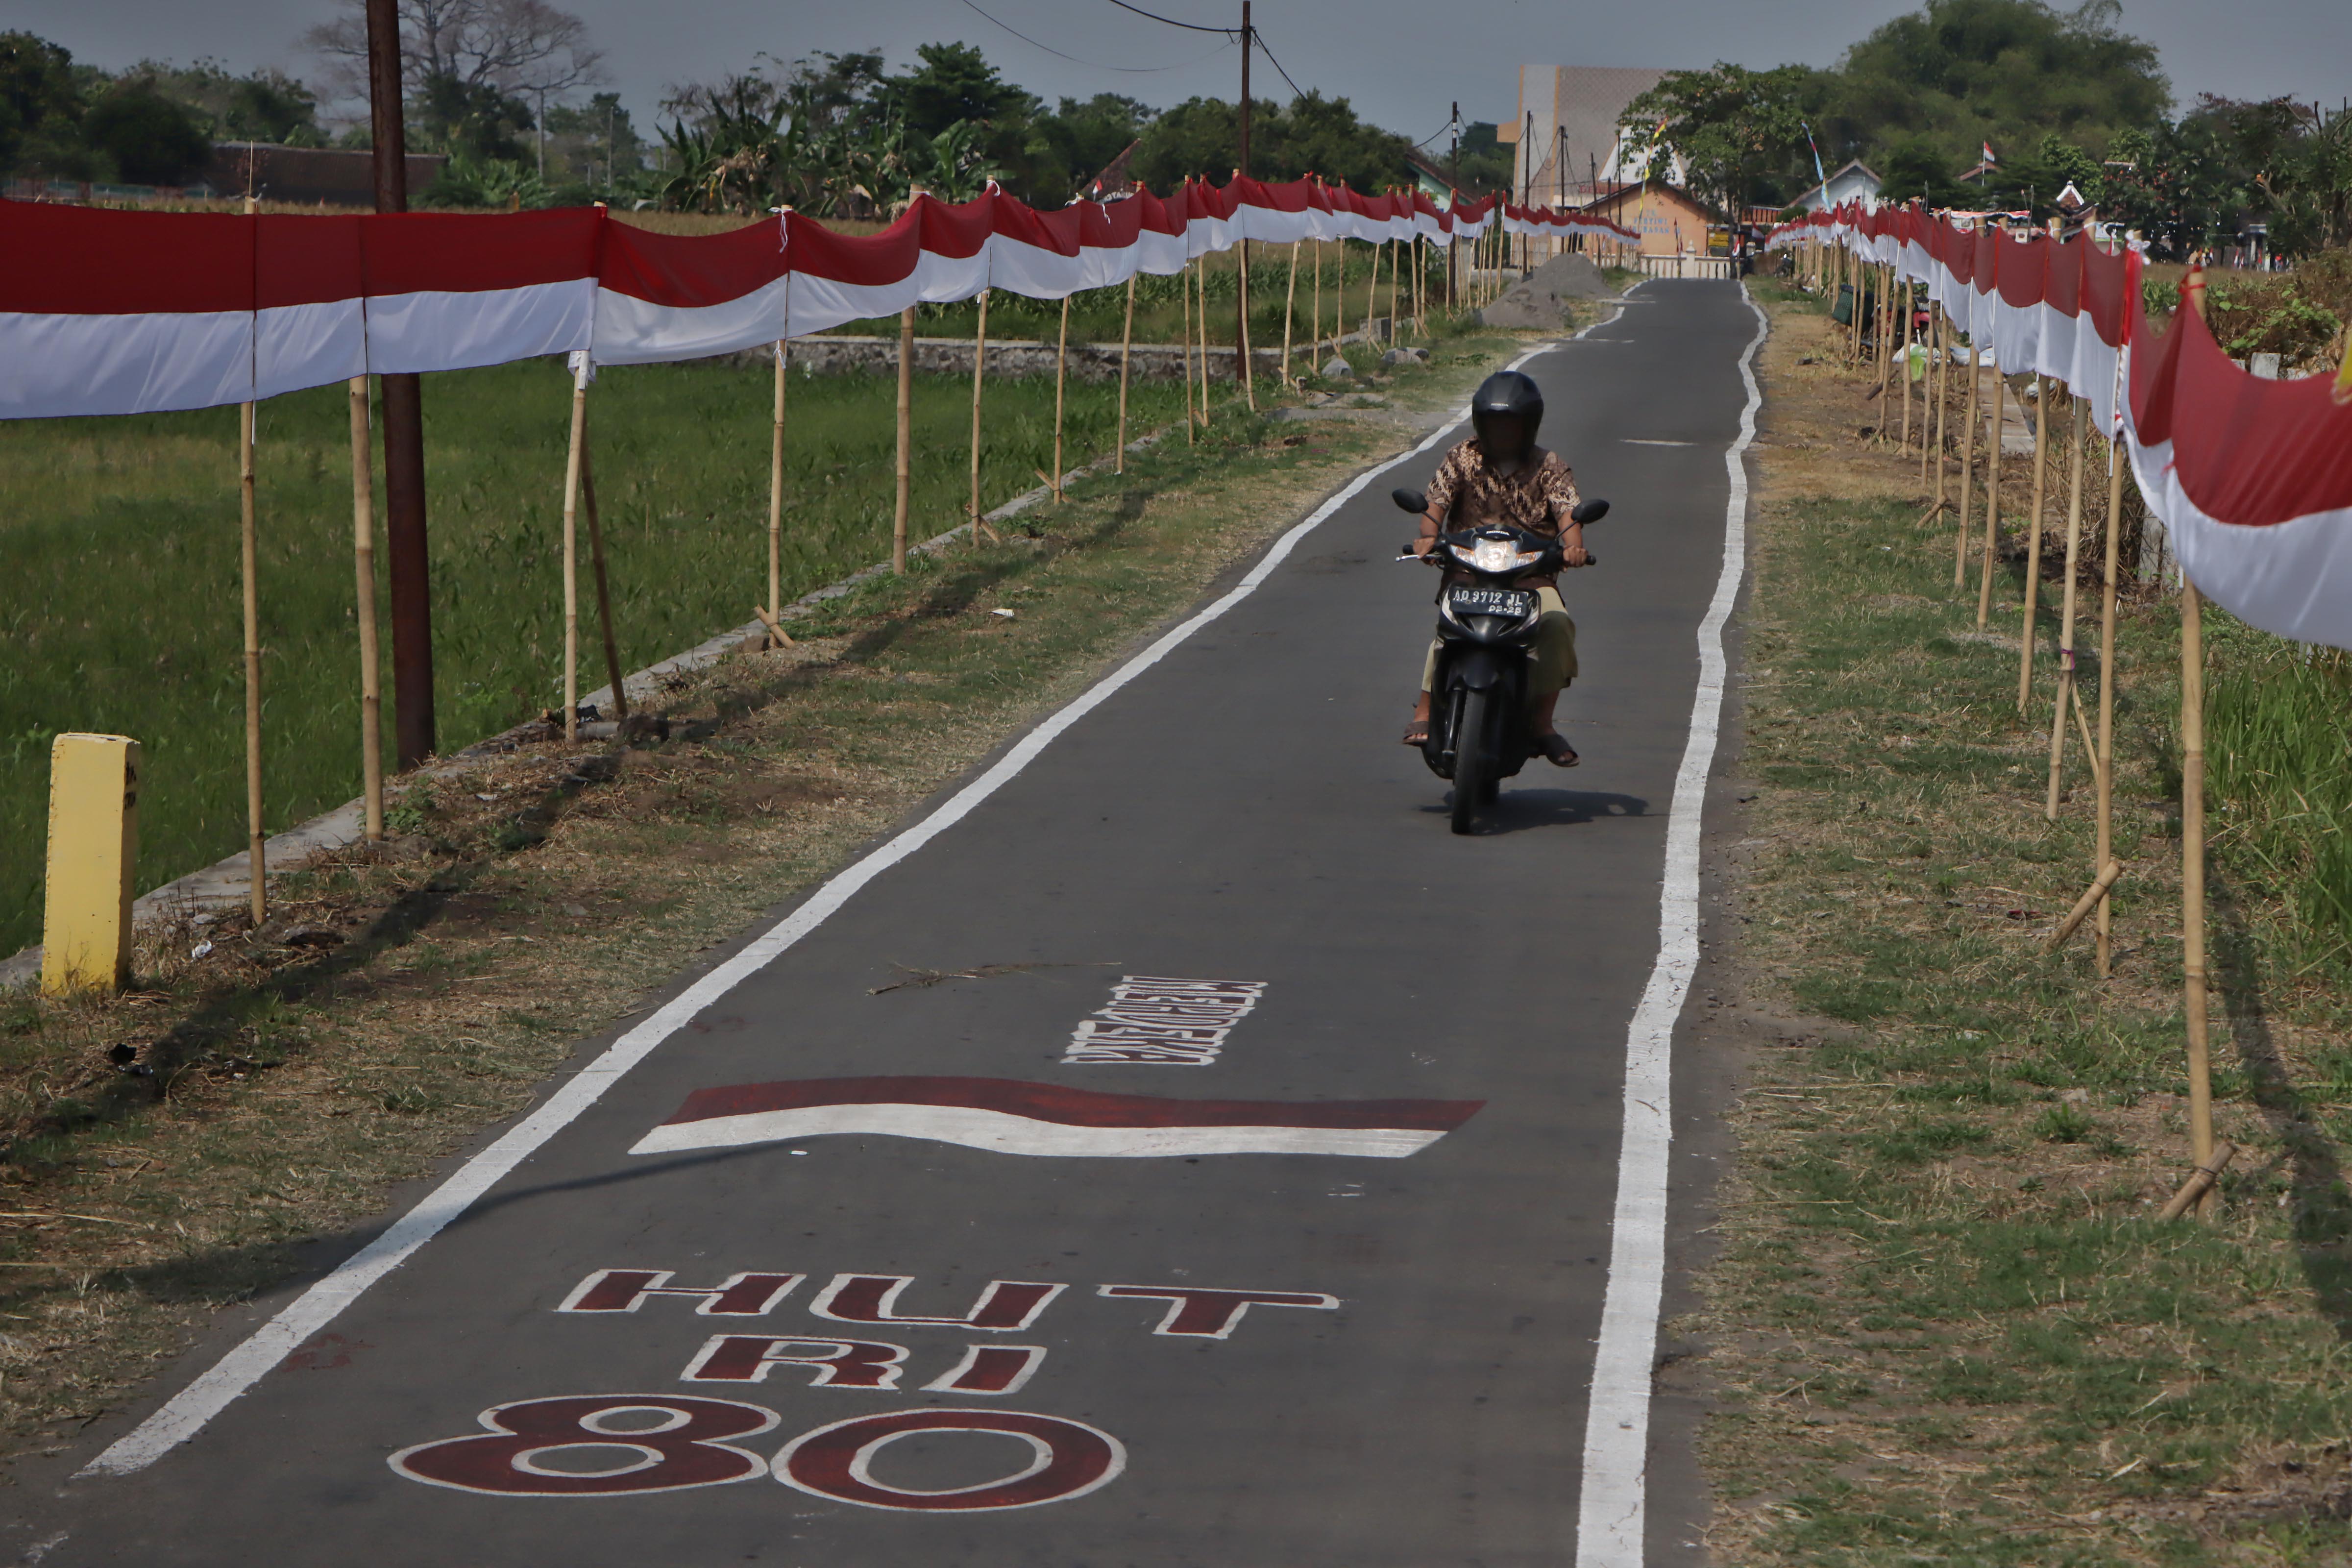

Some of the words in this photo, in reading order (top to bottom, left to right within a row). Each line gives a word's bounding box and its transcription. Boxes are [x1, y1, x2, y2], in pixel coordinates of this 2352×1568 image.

[1453, 590, 1470, 601] AD
[1507, 593, 1523, 606] JL
[1059, 975, 1269, 1066] MERDEKA
[553, 1268, 1340, 1339] HUT
[679, 1334, 1048, 1395] RI
[386, 1393, 1127, 1513] 80
